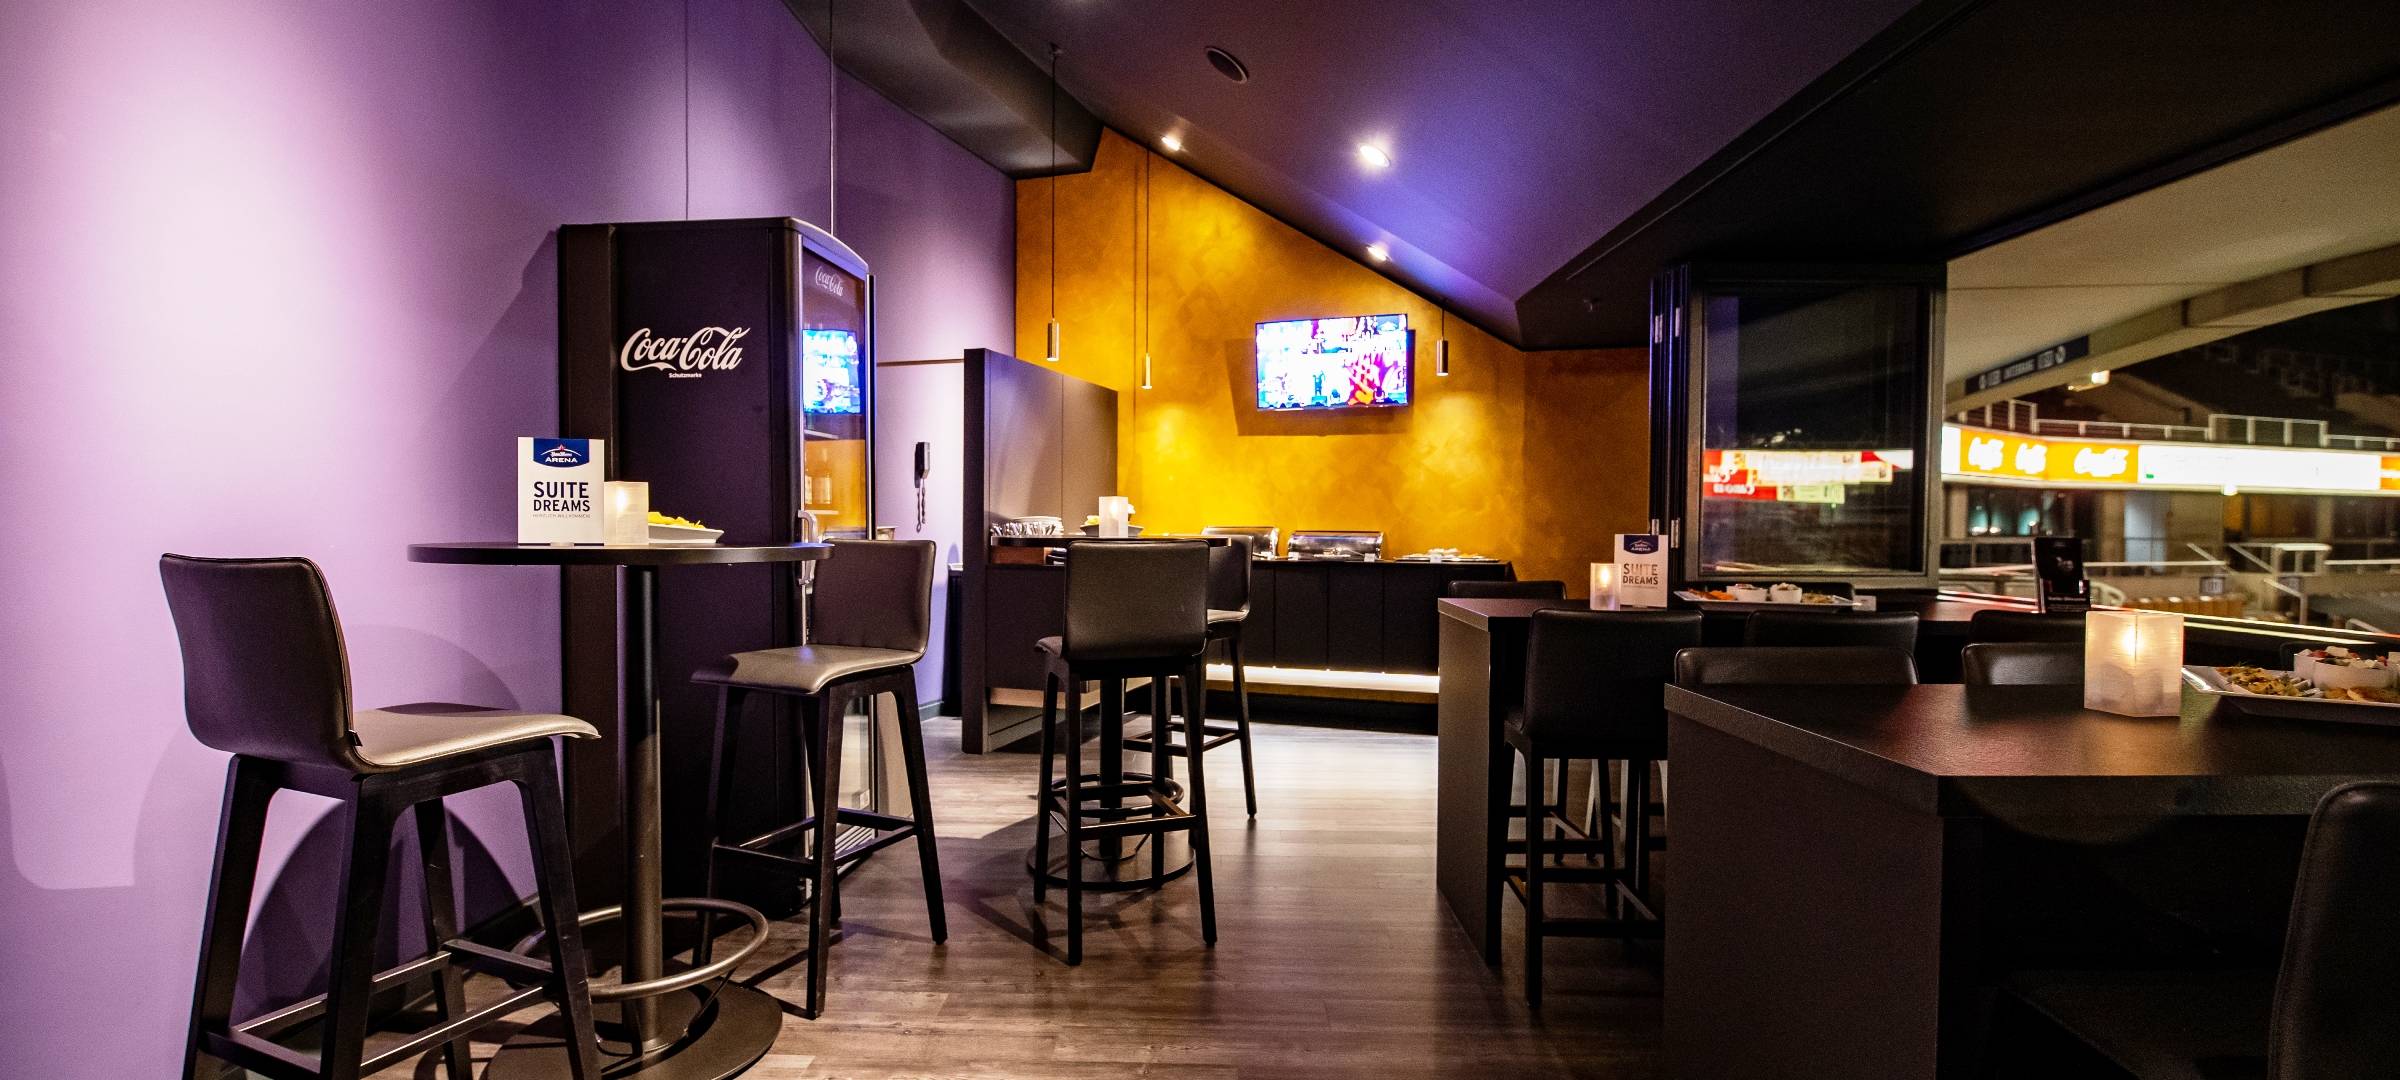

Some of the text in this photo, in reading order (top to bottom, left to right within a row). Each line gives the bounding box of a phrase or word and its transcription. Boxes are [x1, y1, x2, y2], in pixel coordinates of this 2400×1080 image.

[620, 327, 751, 371] Coca-Cola
[533, 481, 589, 499] SUITE
[533, 500, 591, 512] DREAMS
[1623, 563, 1658, 576] SUITE
[1623, 576, 1658, 585] DREAMS
